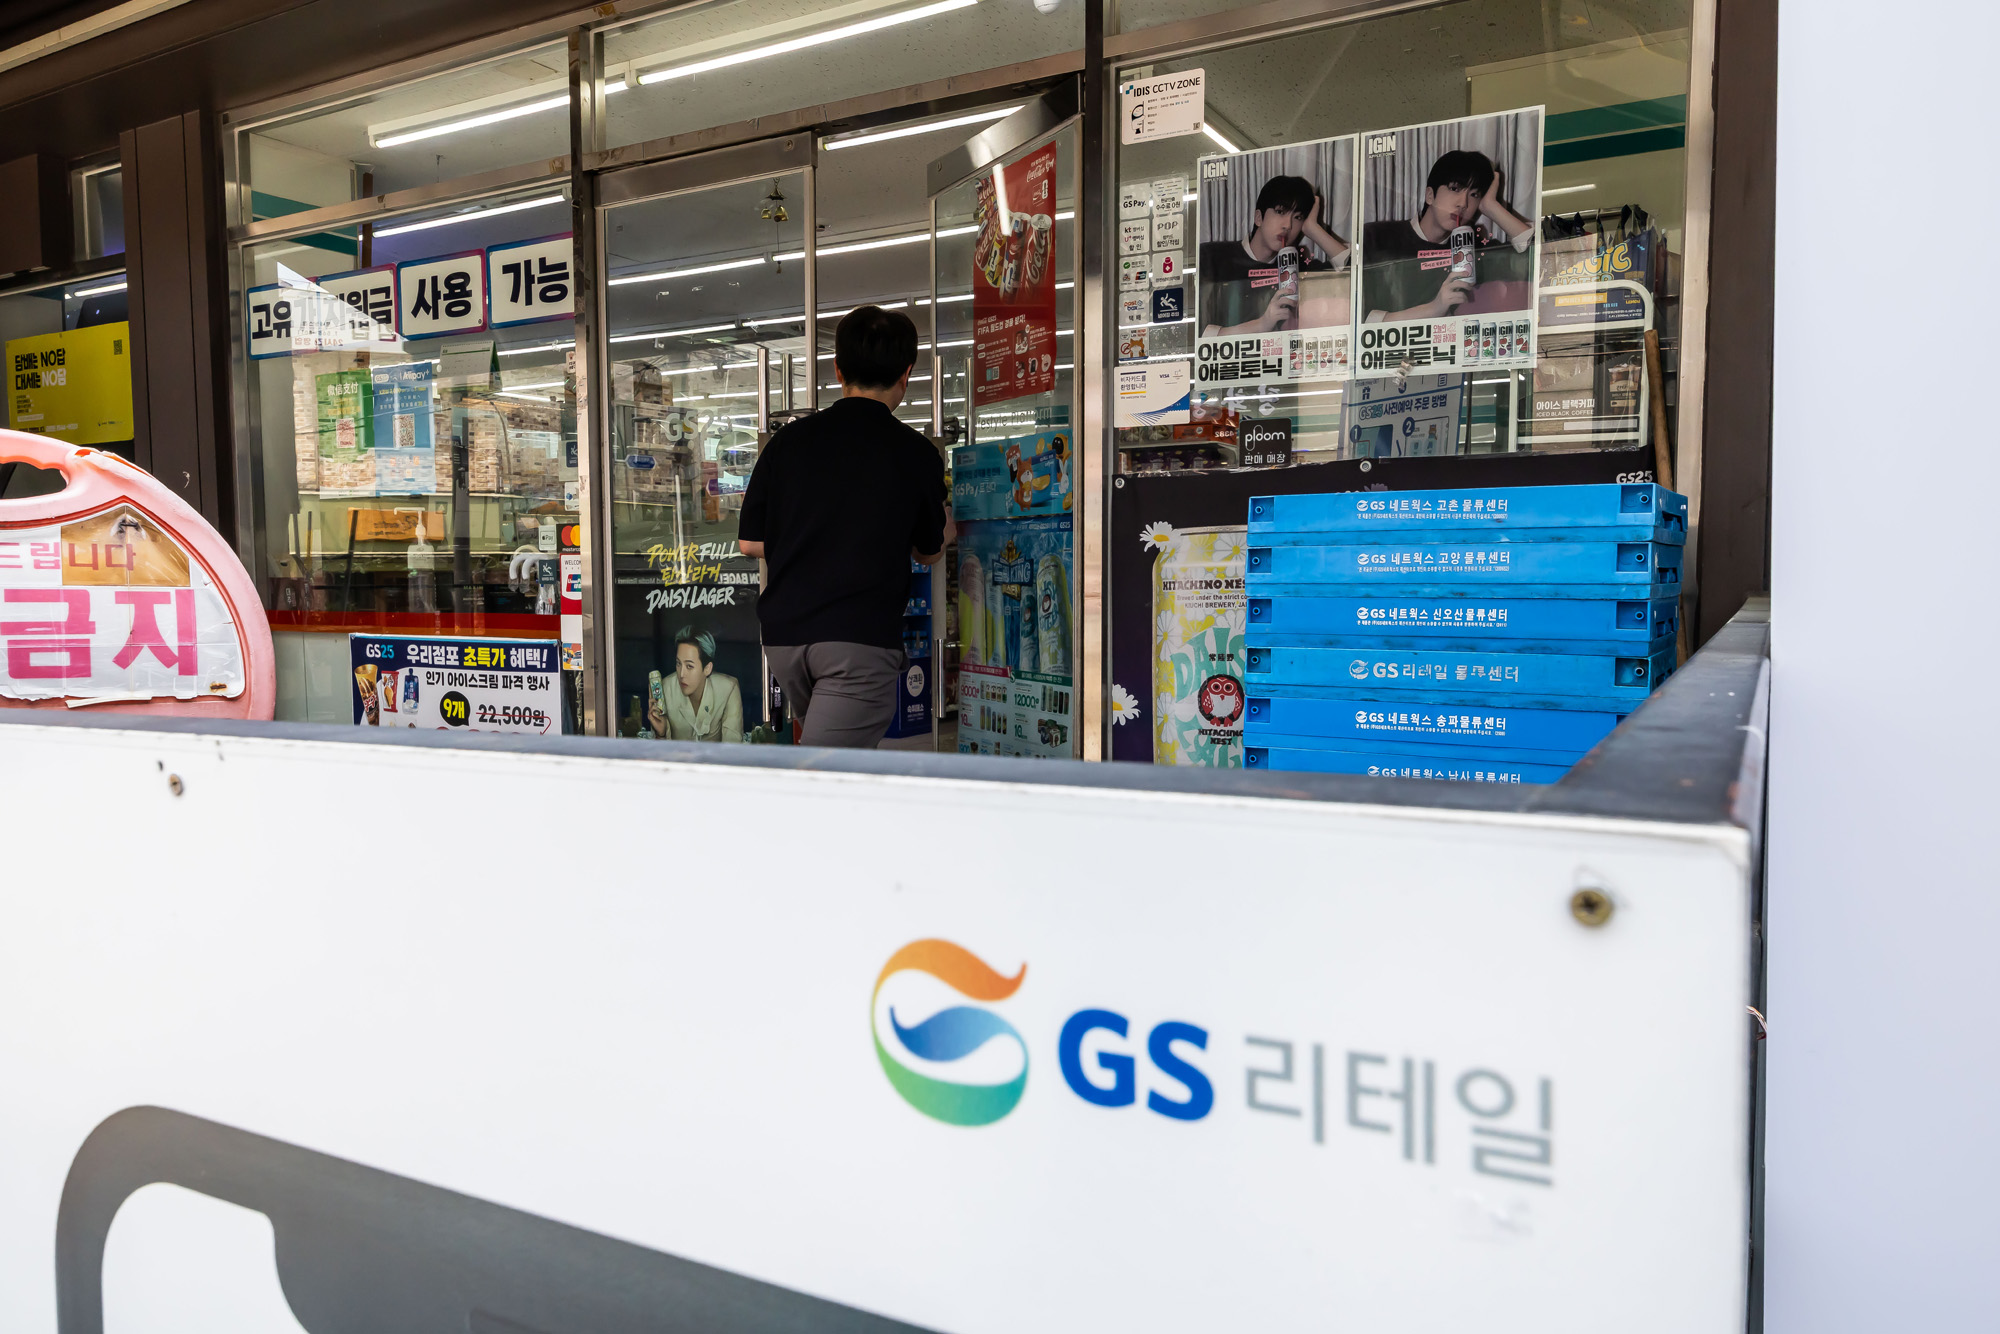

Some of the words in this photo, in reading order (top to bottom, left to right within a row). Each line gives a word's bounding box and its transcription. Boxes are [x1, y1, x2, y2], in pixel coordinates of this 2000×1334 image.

[1134, 86, 1150, 97] IDIS
[1152, 82, 1176, 94] CCTV
[1177, 77, 1201, 89] ZONE
[1368, 135, 1396, 154] IGIN
[1203, 161, 1228, 179] IGIN
[1123, 200, 1133, 208] GS
[1157, 221, 1178, 231] POP
[1451, 232, 1474, 248] IGIN
[1279, 253, 1297, 267] IGIN
[411, 271, 473, 320] 사용
[502, 257, 569, 306] 가능
[978, 326, 989, 336] FIFA
[1464, 325, 1480, 337] IGIN
[1482, 326, 1496, 337] IGIN
[1499, 325, 1512, 336] IGIN
[1516, 323, 1529, 334] IGIN
[1290, 339, 1303, 350] IGIN
[15, 353, 38, 372] 담배는
[1361, 344, 1456, 370] 애플토닉
[1198, 358, 1283, 382] 애플토닉
[15, 372, 41, 390] 대세는
[1120, 383, 1146, 391] 환영합니다
[327, 382, 359, 396] 微信支付
[1360, 404, 1383, 420] GS25
[1383, 399, 1413, 415] 사전예약
[1415, 397, 1430, 411] 주문
[1431, 394, 1448, 409] 방법
[1536, 401, 1561, 411] 아이스
[1562, 399, 1595, 409] 블랙커피
[1406, 421, 1412, 433] 2
[1245, 424, 1286, 451] ploom
[1245, 452, 1263, 465] 판매
[1267, 451, 1285, 464] 매장
[1616, 470, 1653, 484] GS25
[1370, 501, 1385, 511] GS
[1389, 500, 1432, 511] 네트웍스
[1437, 500, 1459, 511] 고촌
[1462, 499, 1508, 512] 물류센터
[1371, 554, 1386, 563] GS
[1391, 552, 1434, 565] 네트웍스
[1439, 552, 1461, 564] 고양
[1464, 552, 1510, 565] 물류센터
[1010, 562, 1031, 582] KING
[1163, 580, 1222, 590] HITACHINO
[646, 586, 690, 614] DAISY
[690, 586, 735, 609] LAGER
[1205, 601, 1237, 609] BREWERY,
[1370, 609, 1386, 618] GS
[1389, 607, 1428, 620] 네트웍스
[0, 588, 198, 680] 금지
[366, 644, 395, 659] GS25
[407, 644, 459, 666] 우리점포
[463, 646, 506, 668] 초특가
[510, 648, 548, 669] 혜택!
[1373, 662, 1399, 678] GS
[1403, 664, 1448, 680] 리테일
[426, 671, 445, 687] 인기
[449, 672, 499, 689] 아이스크림
[502, 676, 523, 690] 파격
[527, 676, 550, 691] 행사
[443, 699, 465, 719] 9개
[478, 704, 545, 727] 22,500원
[1369, 712, 1385, 723] GS
[1388, 712, 1432, 726] 네트웍스
[1382, 768, 1397, 777] GS
[1401, 768, 1444, 780] 네트웍스
[1058, 1008, 1214, 1122] GS
[1245, 1035, 1553, 1188] 리테일
